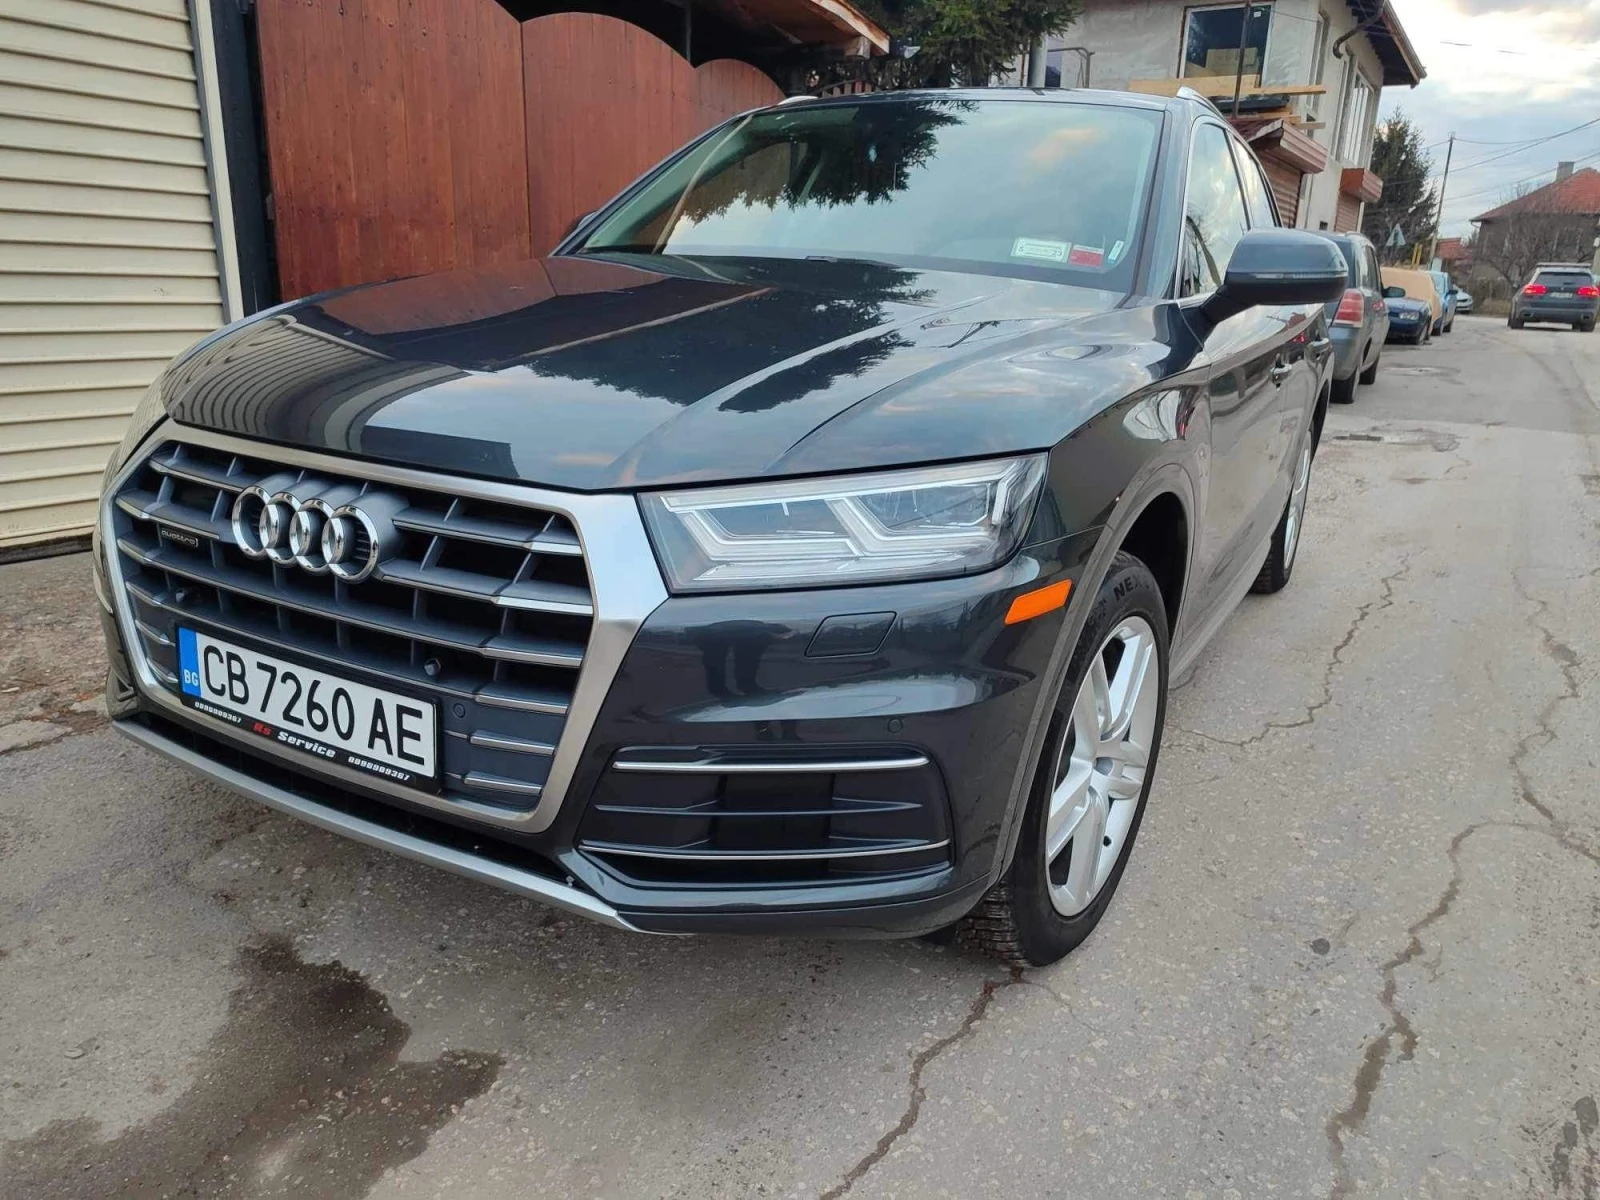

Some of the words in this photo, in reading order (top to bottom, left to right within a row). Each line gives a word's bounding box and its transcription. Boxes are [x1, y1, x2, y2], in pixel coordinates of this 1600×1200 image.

[183, 668, 199, 687] BG
[203, 645, 249, 705] CB
[256, 661, 355, 741] 7260
[367, 698, 426, 766] AE
[277, 731, 336, 758] Service
